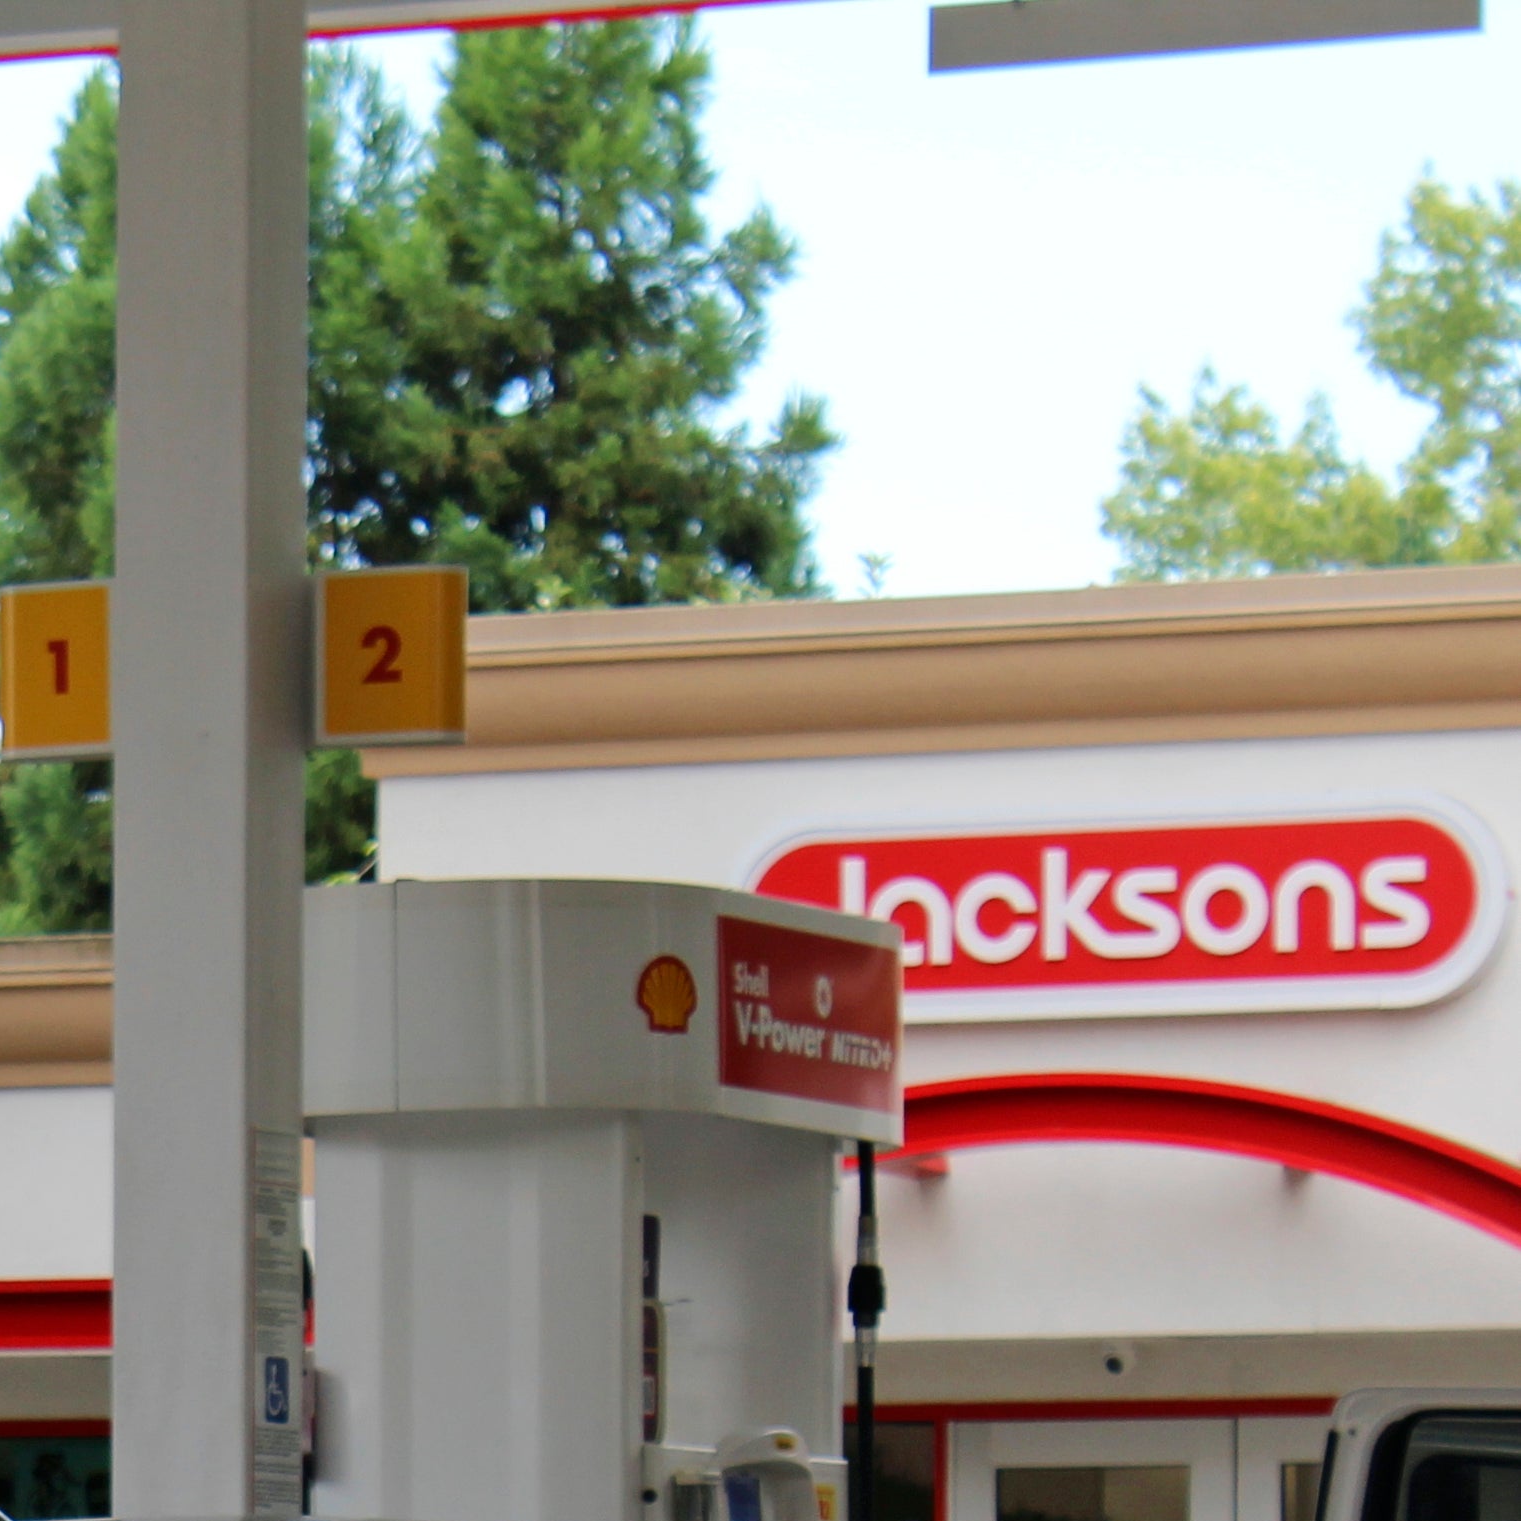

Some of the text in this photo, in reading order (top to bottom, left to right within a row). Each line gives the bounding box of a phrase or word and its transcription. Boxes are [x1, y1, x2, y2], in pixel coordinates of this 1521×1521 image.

[47, 639, 69, 695] 1
[360, 625, 404, 685] 2
[733, 961, 770, 998] Shell
[734, 1000, 826, 1059] V-Power
